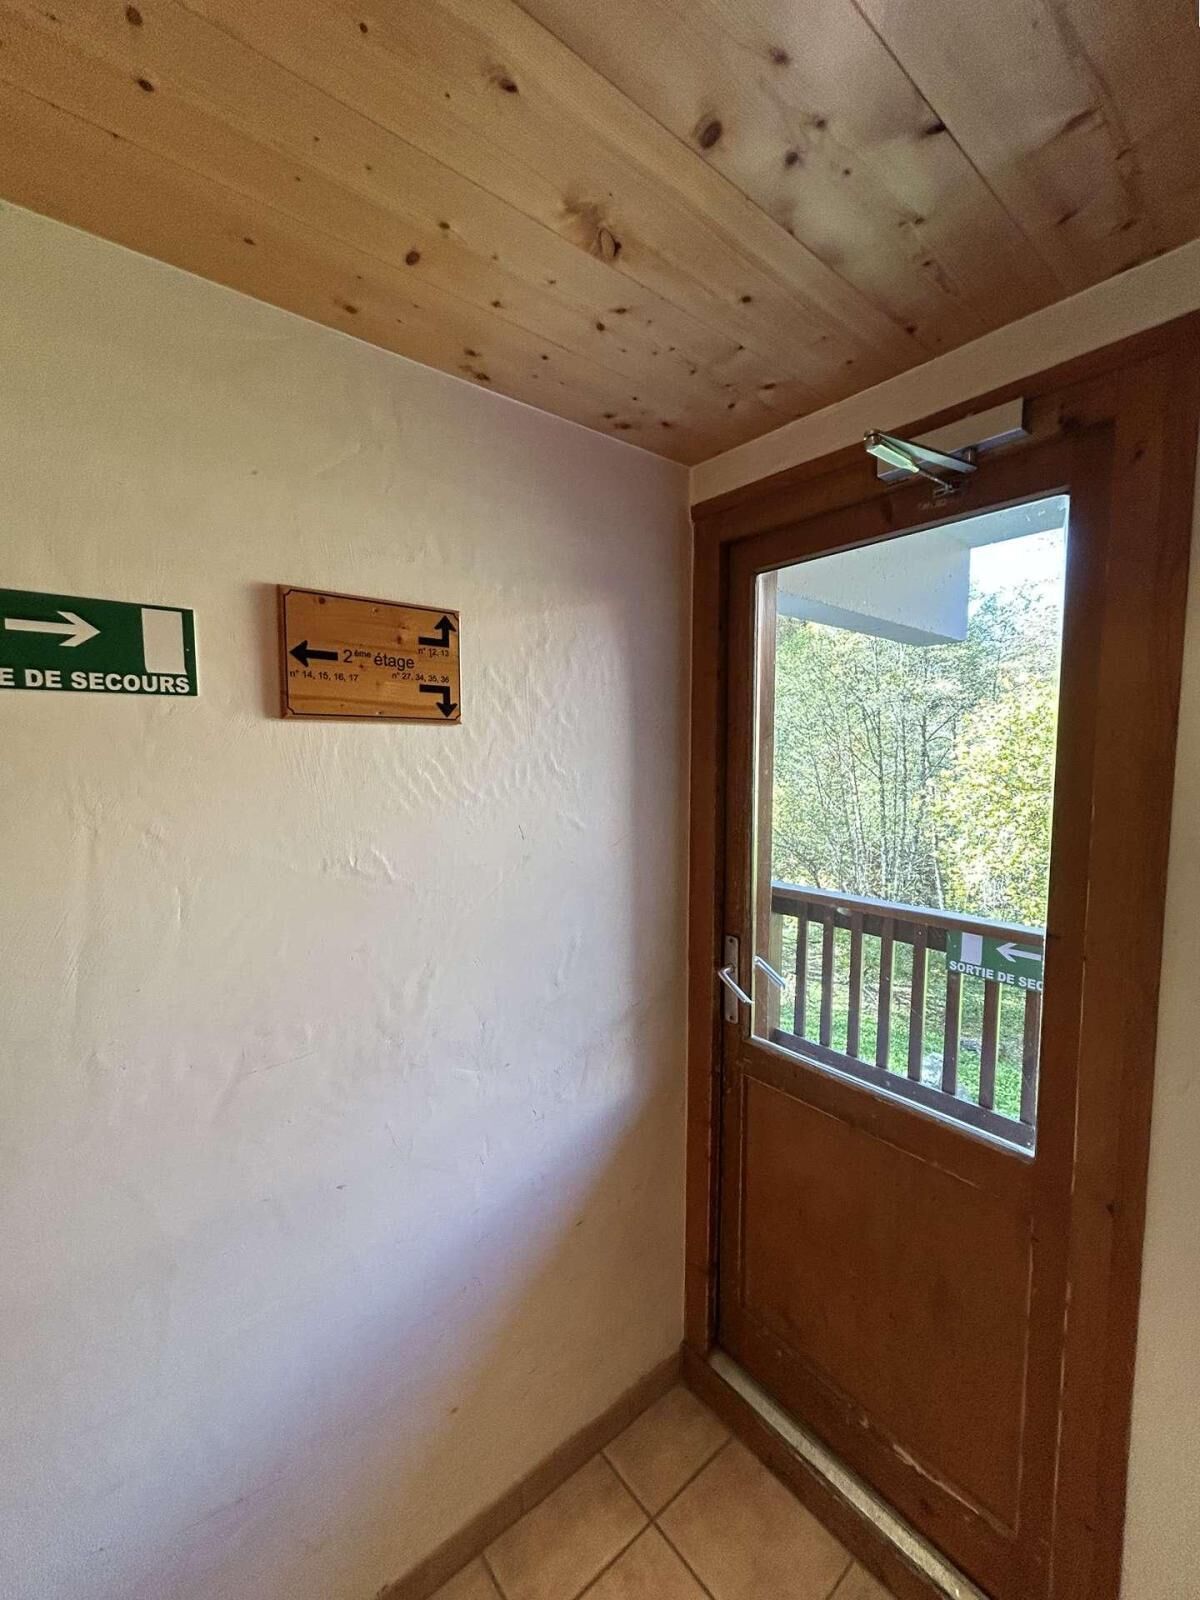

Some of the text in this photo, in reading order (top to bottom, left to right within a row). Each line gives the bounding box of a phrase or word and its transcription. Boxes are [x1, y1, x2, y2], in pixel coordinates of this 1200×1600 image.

[374, 653, 415, 671] étage
[24, 669, 62, 688] DE
[71, 671, 190, 693] SECOURS
[949, 961, 994, 979] SORTIE
[997, 971, 1015, 984] DE
